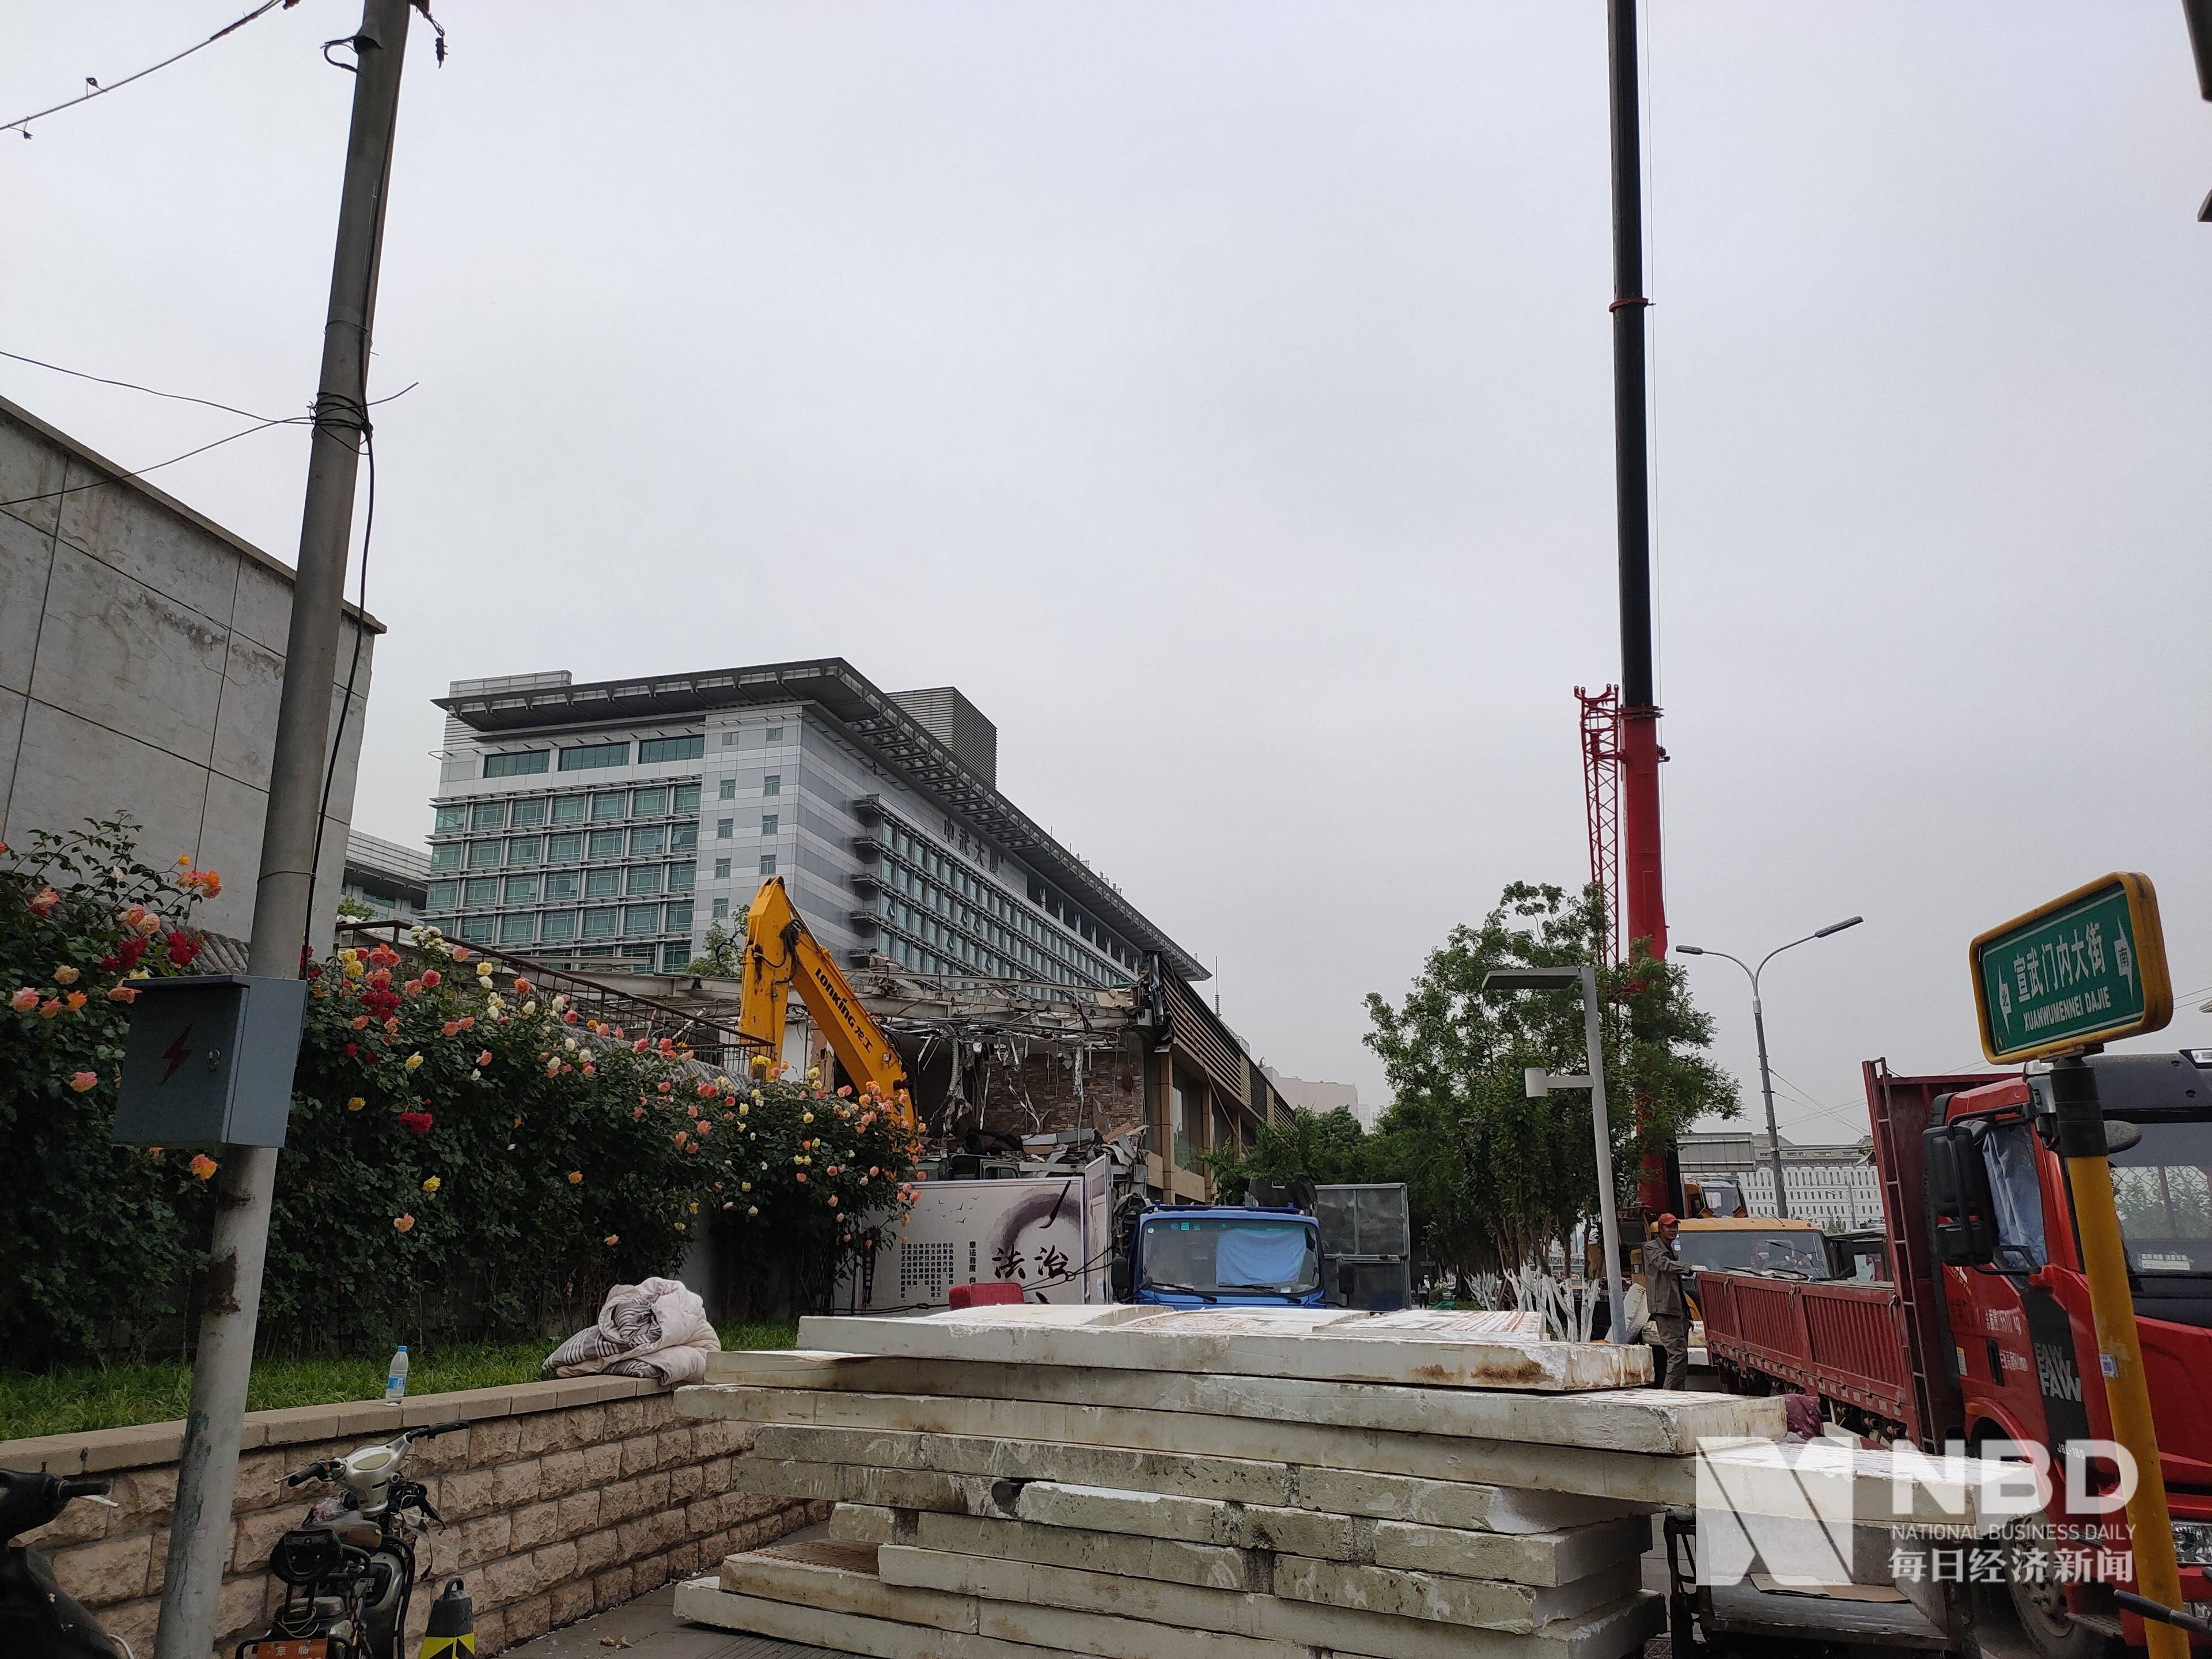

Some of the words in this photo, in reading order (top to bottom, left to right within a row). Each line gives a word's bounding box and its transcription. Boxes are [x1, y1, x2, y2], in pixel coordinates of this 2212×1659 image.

[2013, 922, 2105, 1002] 宣武门内大街
[2118, 947, 2129, 968] 南
[2023, 995, 2084, 1032] XUANWUMENNEI
[2084, 986, 2111, 1013] DAJIE
[992, 1244, 1069, 1279] 法治
[2039, 1372, 2082, 1402] FAW
